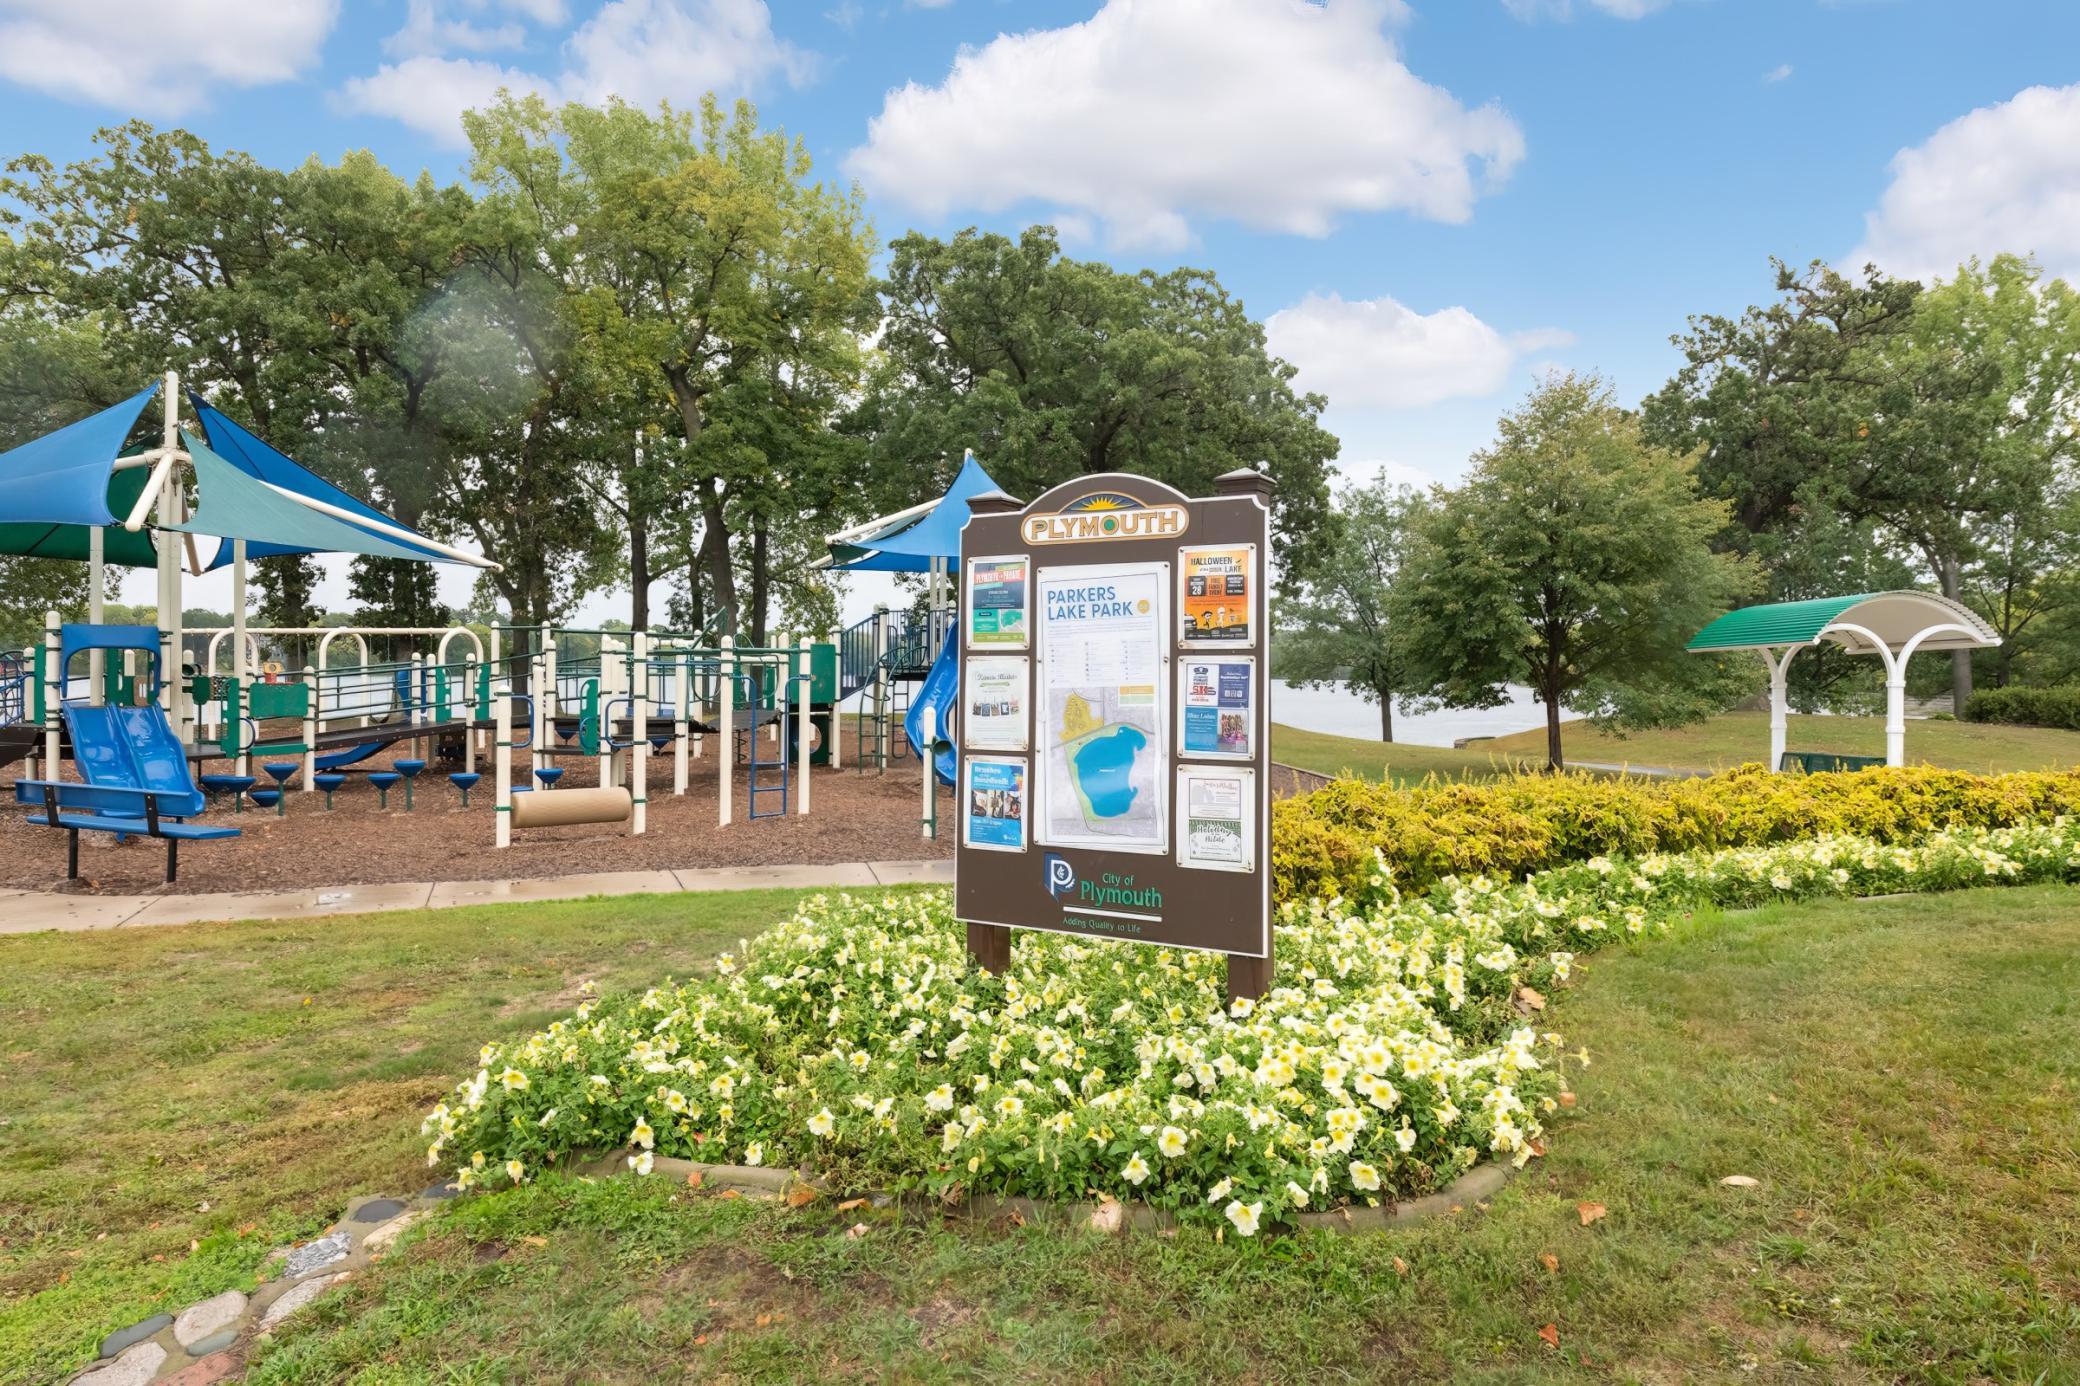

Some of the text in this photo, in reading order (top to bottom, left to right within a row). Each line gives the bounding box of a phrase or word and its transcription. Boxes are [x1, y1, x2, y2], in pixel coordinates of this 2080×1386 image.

[1031, 511, 1178, 540] PLYMOUTH
[1191, 557, 1233, 566] HALLOWEEN
[1047, 586, 1116, 604] PARKERS
[1047, 604, 1086, 620] LAKE
[1092, 601, 1134, 618] PARK
[1102, 873, 1135, 886] City of
[1080, 880, 1163, 908] Plymouth
[1063, 917, 1141, 933] Adding Quality to Life
